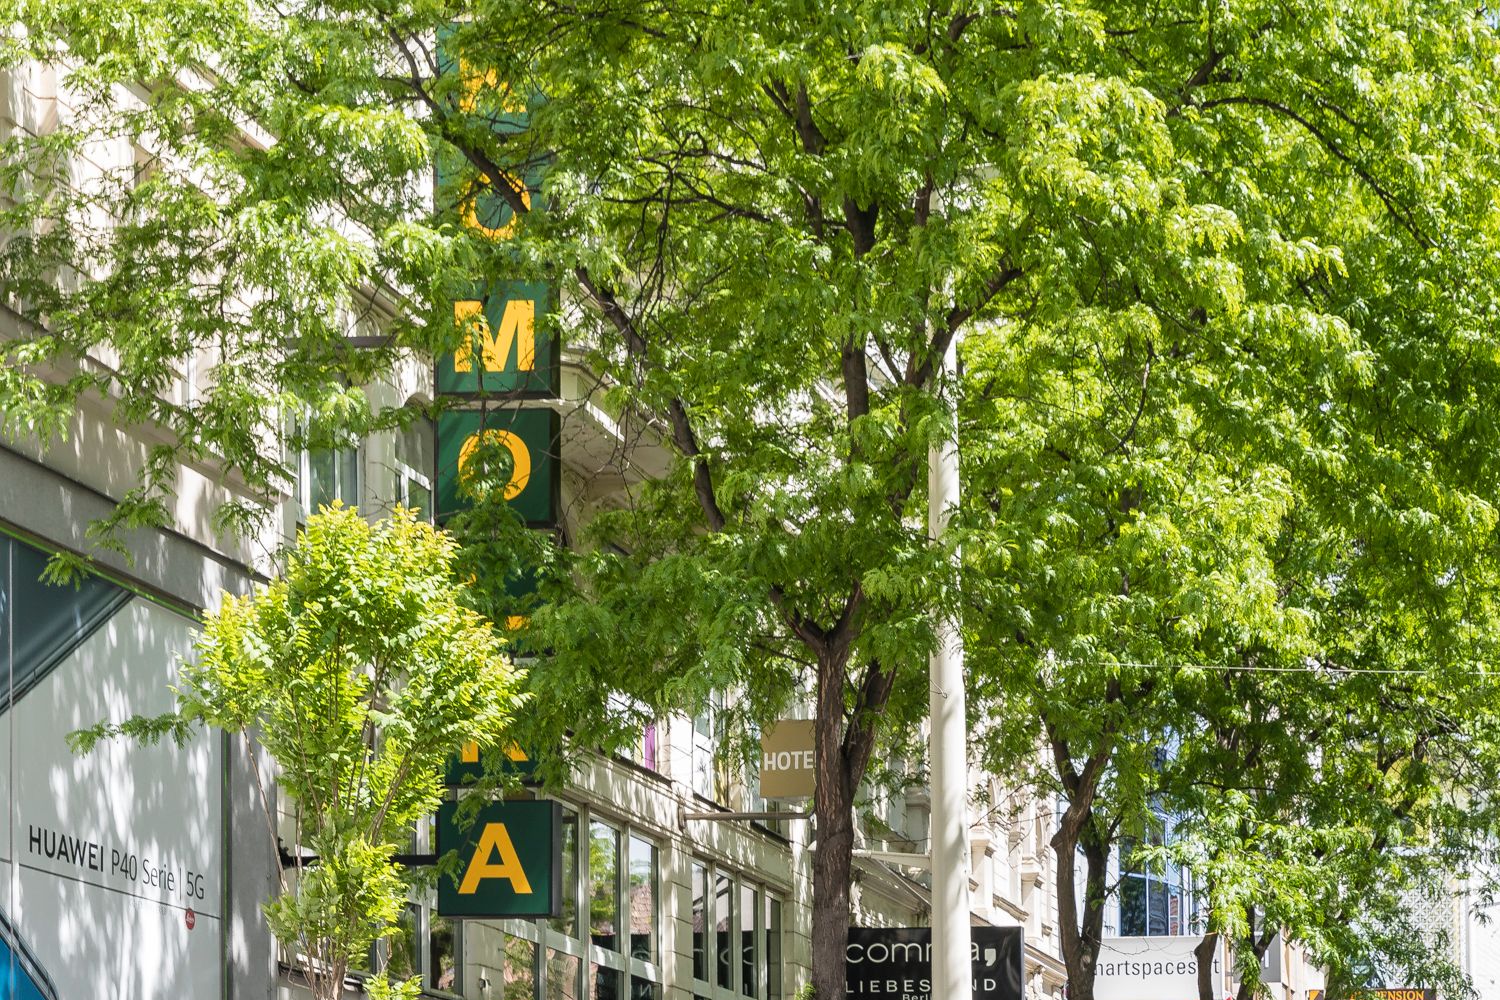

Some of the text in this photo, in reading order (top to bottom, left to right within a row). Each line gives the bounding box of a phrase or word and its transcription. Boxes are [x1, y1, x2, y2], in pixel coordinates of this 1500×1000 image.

[29, 825, 104, 872] HUAWEI
[111, 848, 138, 881] P40
[142, 859, 175, 891] Serie
[186, 871, 205, 900] 5G
[846, 942, 996, 967] coma,
[1377, 990, 1425, 1000] ENSION
